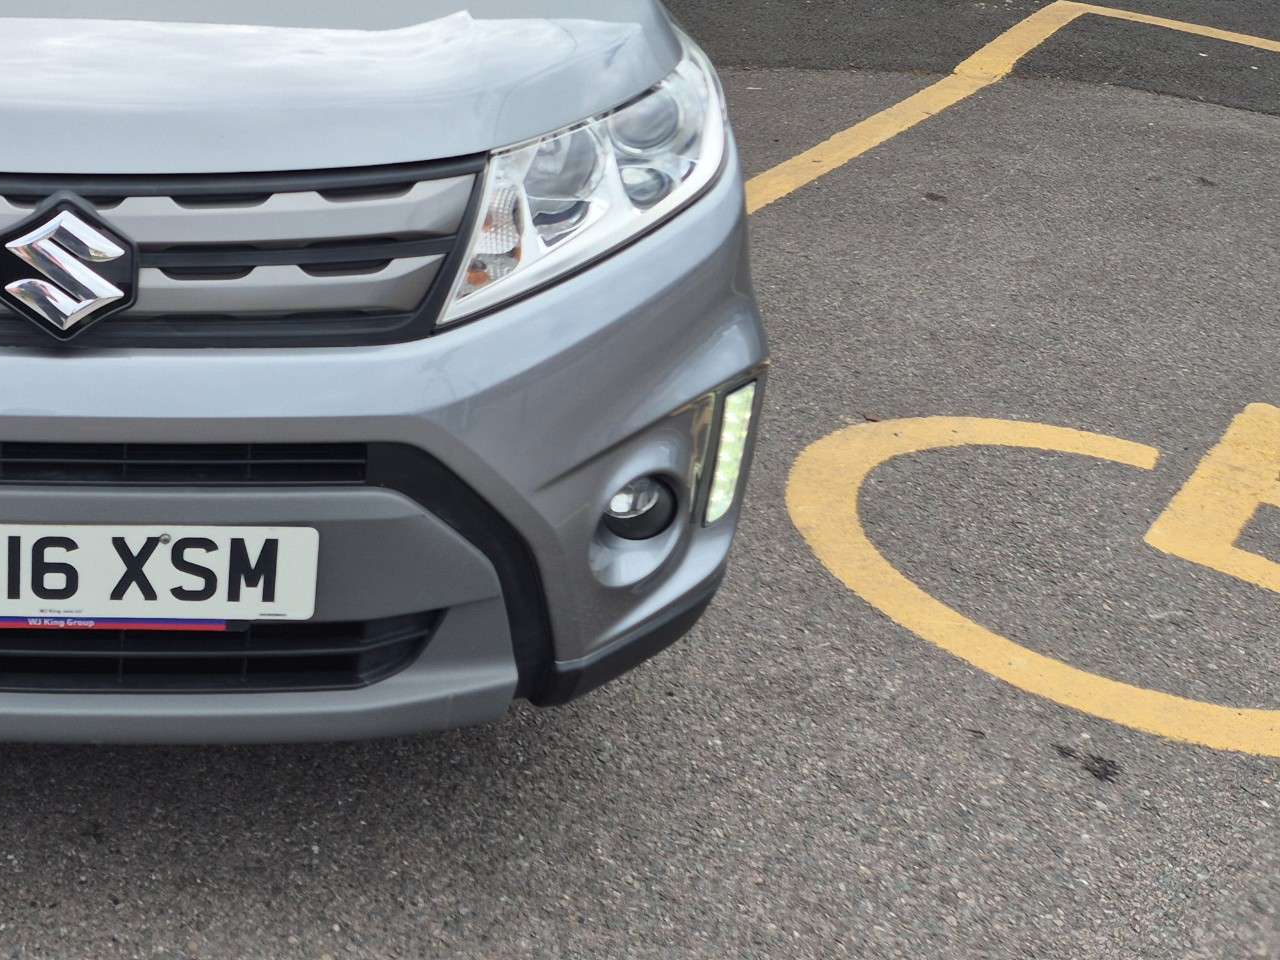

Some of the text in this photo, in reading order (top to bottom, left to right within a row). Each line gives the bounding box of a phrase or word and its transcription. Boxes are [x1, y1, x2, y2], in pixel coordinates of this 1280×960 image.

[109, 536, 280, 602] XSM
[27, 617, 96, 628] WJ King Group
